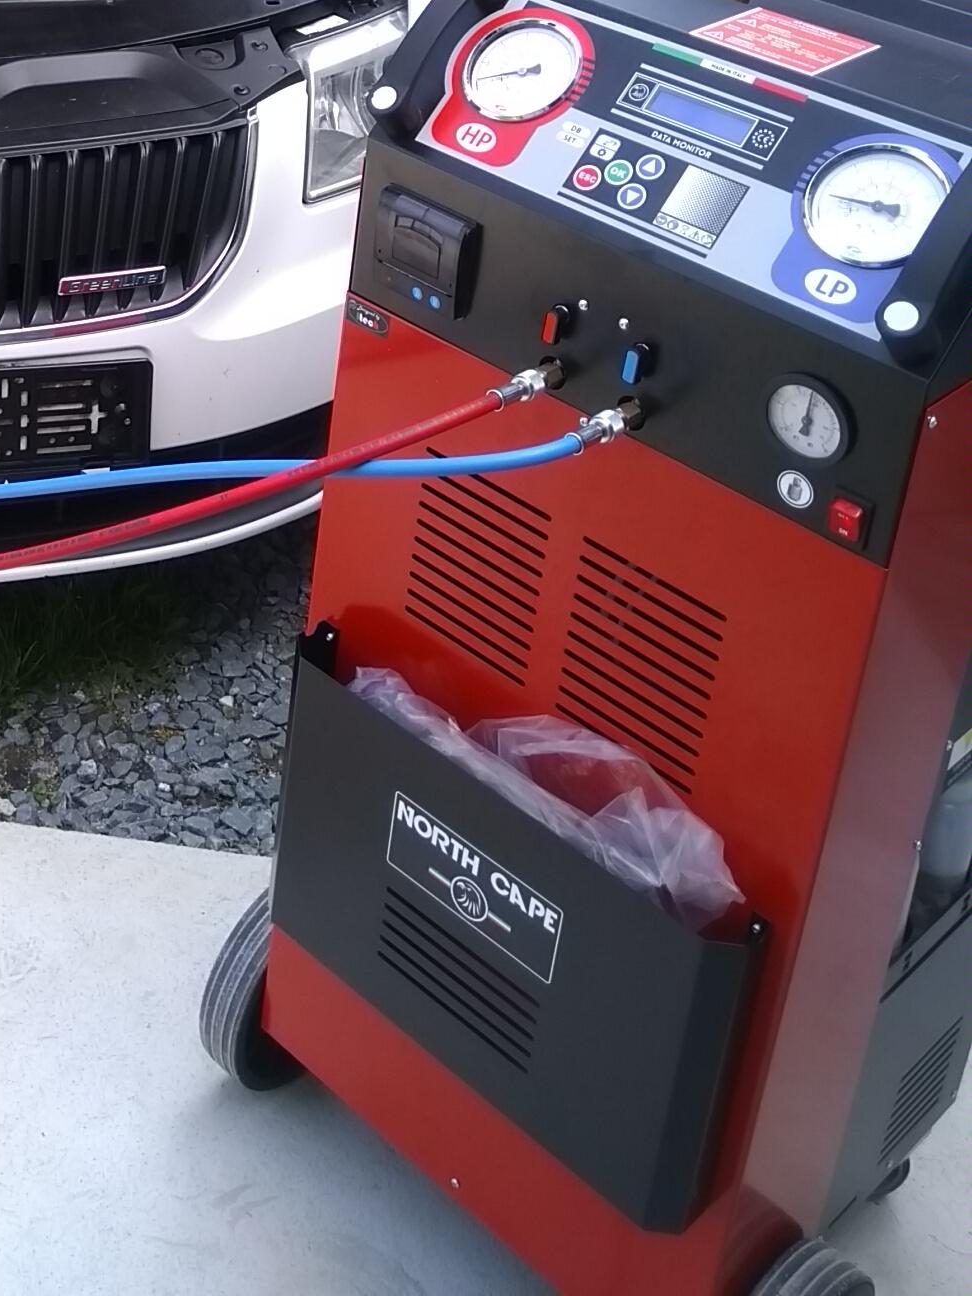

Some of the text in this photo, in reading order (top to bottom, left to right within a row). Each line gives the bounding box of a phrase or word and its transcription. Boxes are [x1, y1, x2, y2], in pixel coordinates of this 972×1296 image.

[461, 126, 493, 147] HP
[570, 125, 582, 134] DB
[563, 134, 577, 144] SET
[651, 130, 712, 159] DATA MONITOR
[578, 170, 597, 184] ESC
[609, 166, 627, 179] OK
[815, 274, 849, 298] LP
[397, 800, 558, 934] NORTH CAPE
